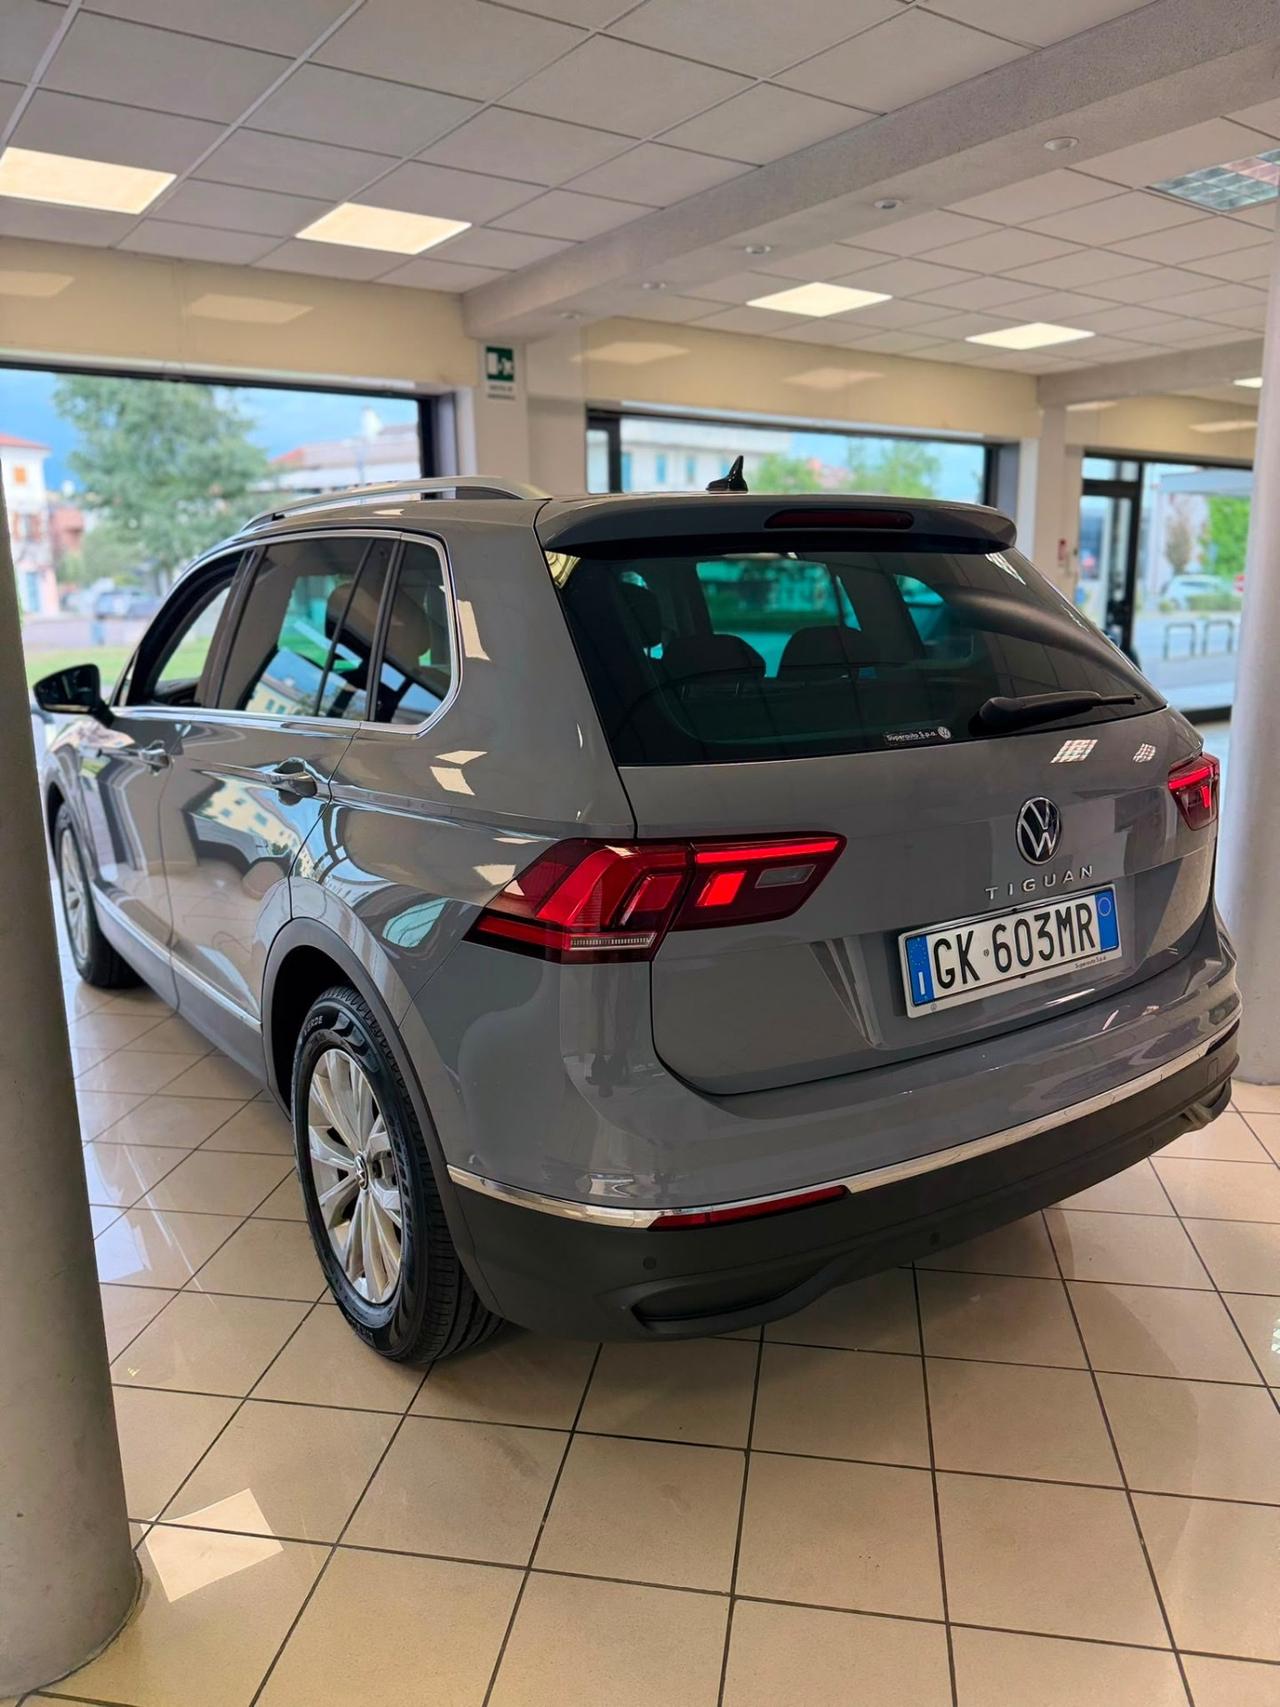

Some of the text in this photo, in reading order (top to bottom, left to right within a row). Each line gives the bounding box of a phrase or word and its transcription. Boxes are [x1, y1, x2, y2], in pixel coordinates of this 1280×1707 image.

[985, 865, 1093, 900] TIGUAN
[933, 903, 1096, 989] GK 603MR
[918, 971, 926, 995] I
